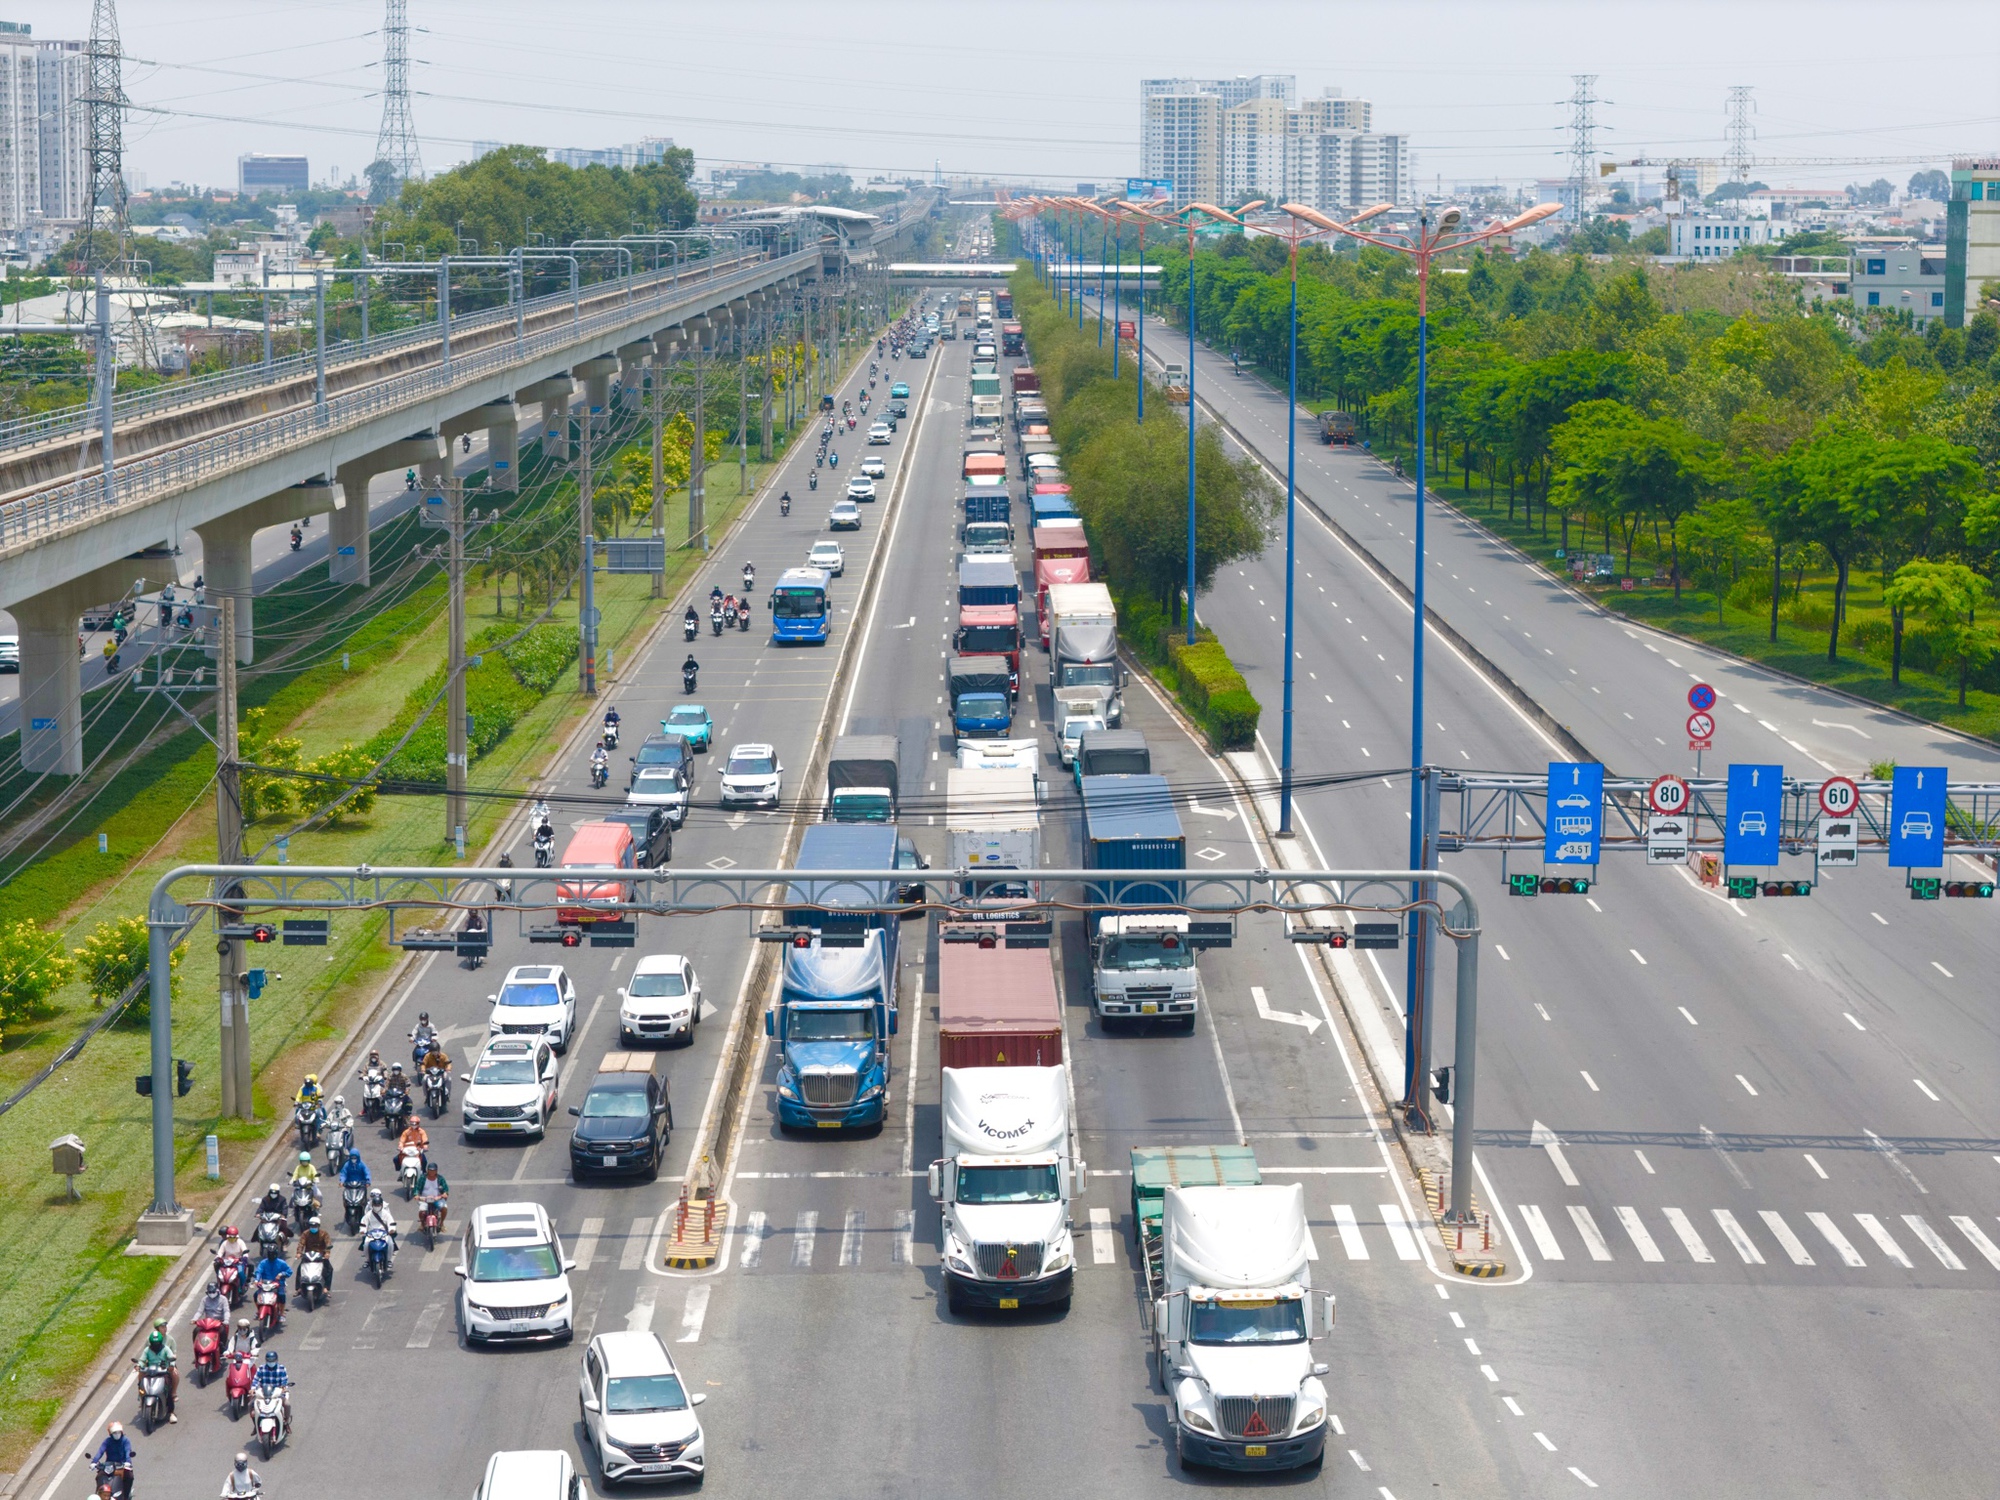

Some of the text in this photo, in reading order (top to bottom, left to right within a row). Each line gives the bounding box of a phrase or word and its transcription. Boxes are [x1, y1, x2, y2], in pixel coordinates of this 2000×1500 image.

[1660, 786, 1679, 803] 80
[1828, 788, 1848, 804] 60
[1511, 874, 1536, 895] 42
[1730, 877, 1754, 897] 42
[1913, 878, 1937, 898] 42
[978, 1118, 1035, 1139] VICOMEX
